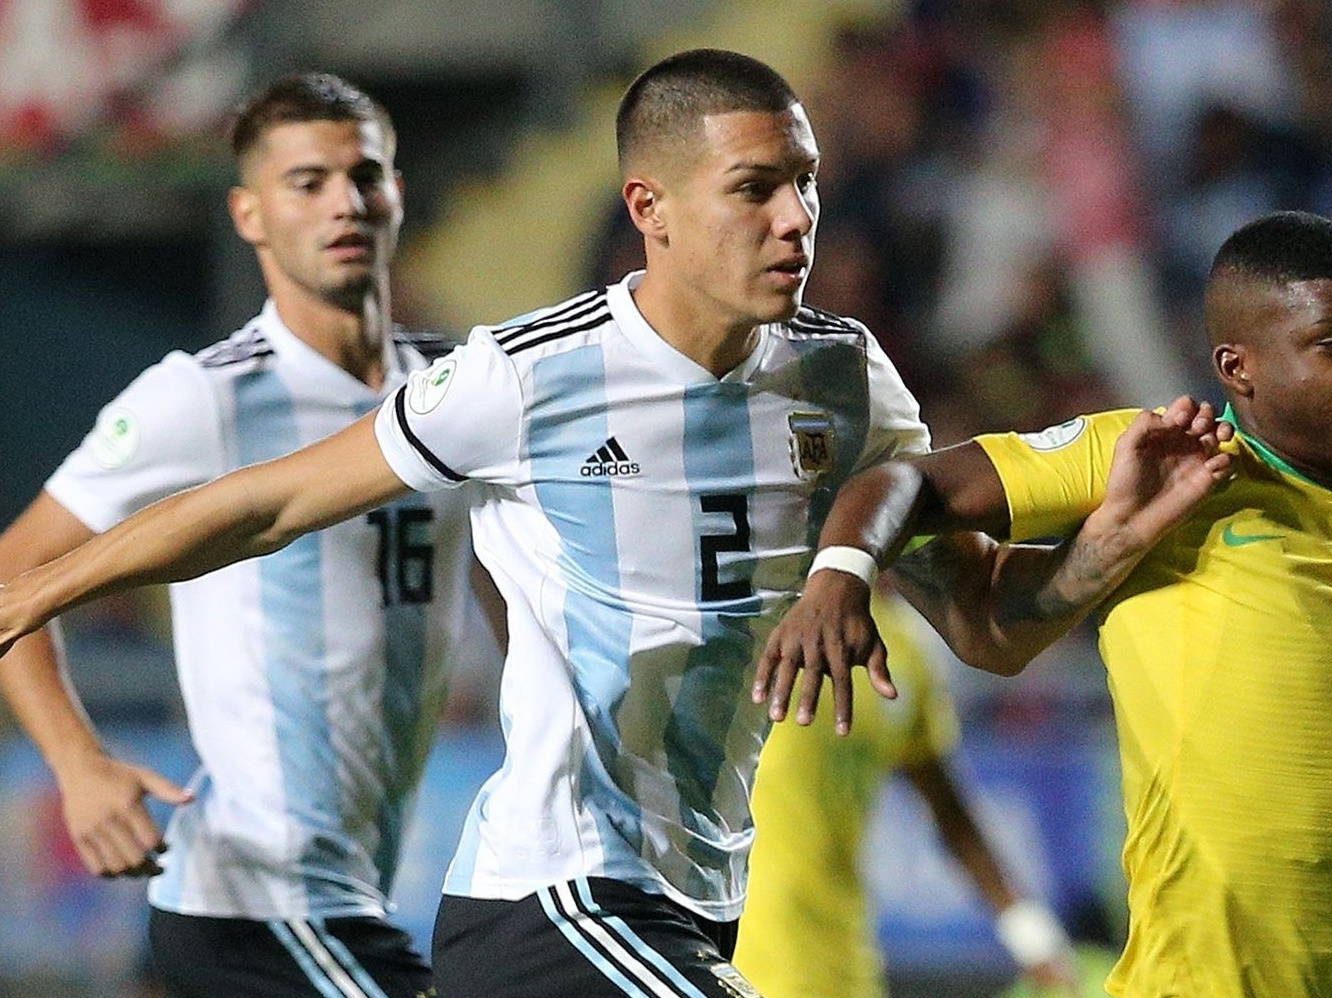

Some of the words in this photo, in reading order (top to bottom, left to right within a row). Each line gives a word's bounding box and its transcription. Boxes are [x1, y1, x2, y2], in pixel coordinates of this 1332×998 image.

[580, 461, 640, 477] adidas
[367, 508, 434, 607] 16
[700, 494, 752, 602] 2
